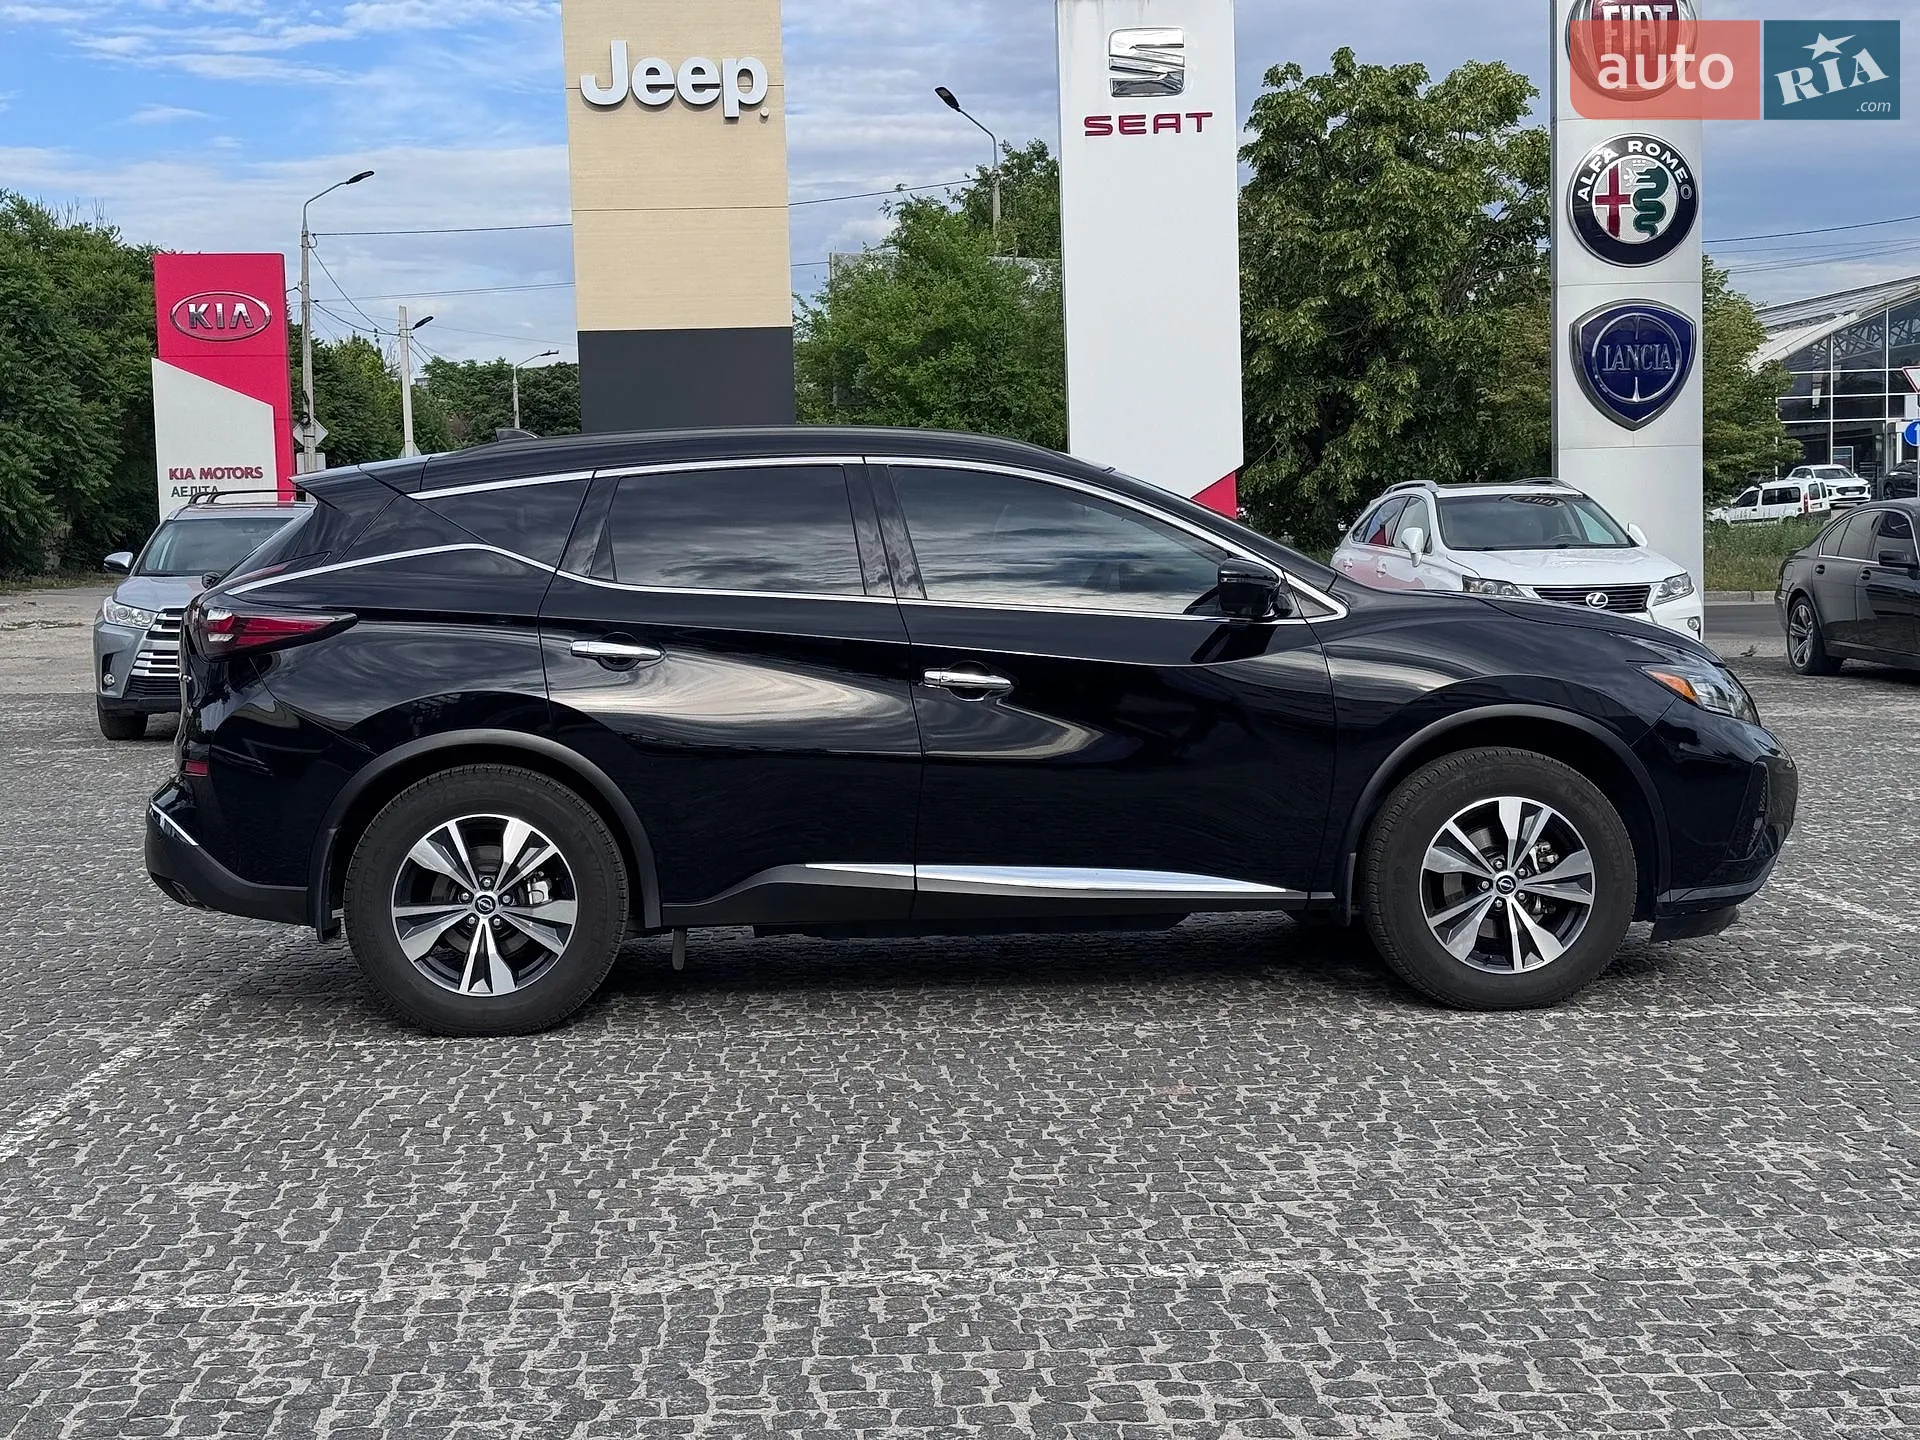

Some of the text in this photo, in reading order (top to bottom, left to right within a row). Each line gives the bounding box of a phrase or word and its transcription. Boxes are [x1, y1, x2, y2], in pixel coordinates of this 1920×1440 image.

[1602, 4, 1673, 60] FIAT
[580, 40, 768, 118] Jeep
[1083, 111, 1213, 137] SEAT
[1576, 140, 1693, 202] ALFA ROMEO
[187, 303, 255, 330] KIA
[1601, 343, 1674, 373] LANCIA
[168, 466, 264, 481] KIA MOTORS
